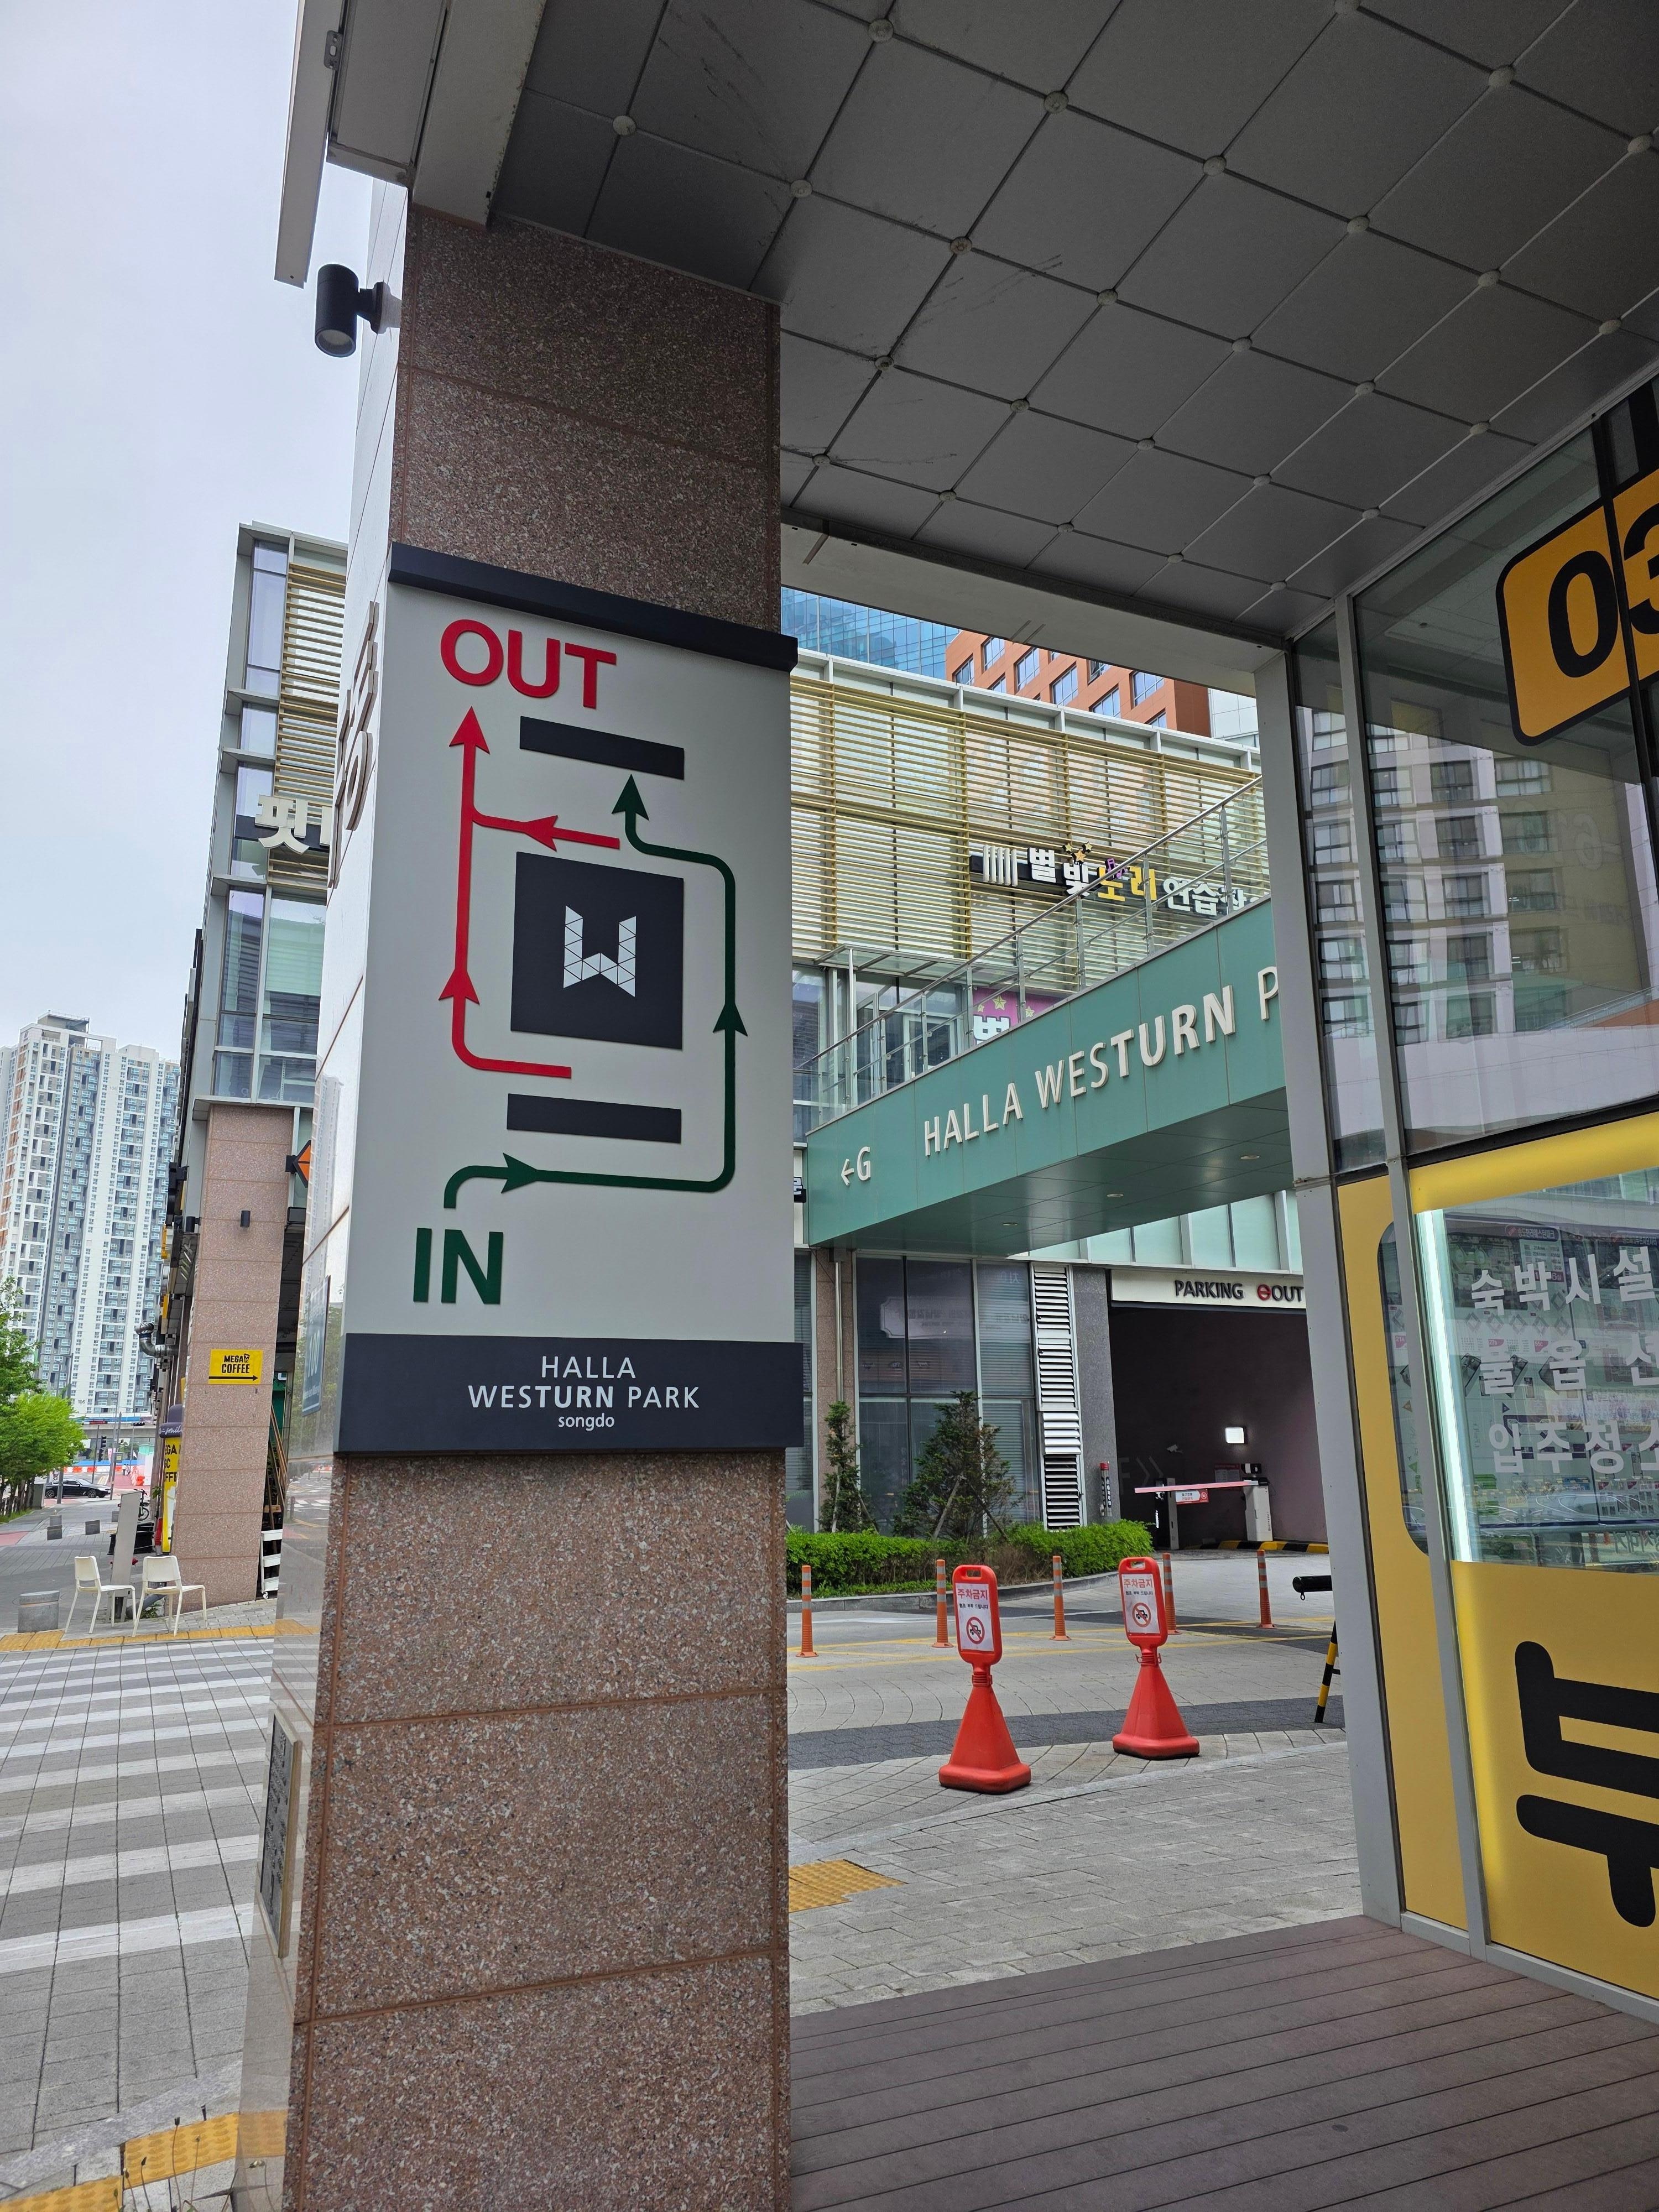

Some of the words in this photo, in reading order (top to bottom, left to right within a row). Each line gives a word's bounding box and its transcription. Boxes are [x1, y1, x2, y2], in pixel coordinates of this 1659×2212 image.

[441, 620, 617, 709] OUT
[924, 1082, 1024, 1157] HALLA
[1035, 984, 1236, 1109] WESTURN
[857, 1146, 871, 1181] G
[413, 1228, 503, 1305] IN
[1174, 1280, 1244, 1300] PARKING
[1272, 1285, 1304, 1302] OUT
[1472, 1246, 1655, 1316] 숙박시설
[221, 1364, 251, 1374] COFFEE
[223, 1355, 244, 1363] MEGA
[541, 1355, 636, 1379] HALLA
[468, 1385, 613, 1408] WESTURN
[628, 1386, 700, 1408] PARK
[558, 1412, 615, 1431] songdo
[957, 1588, 988, 1601] 주차금지
[1123, 1578, 1153, 1589] 주차금지
